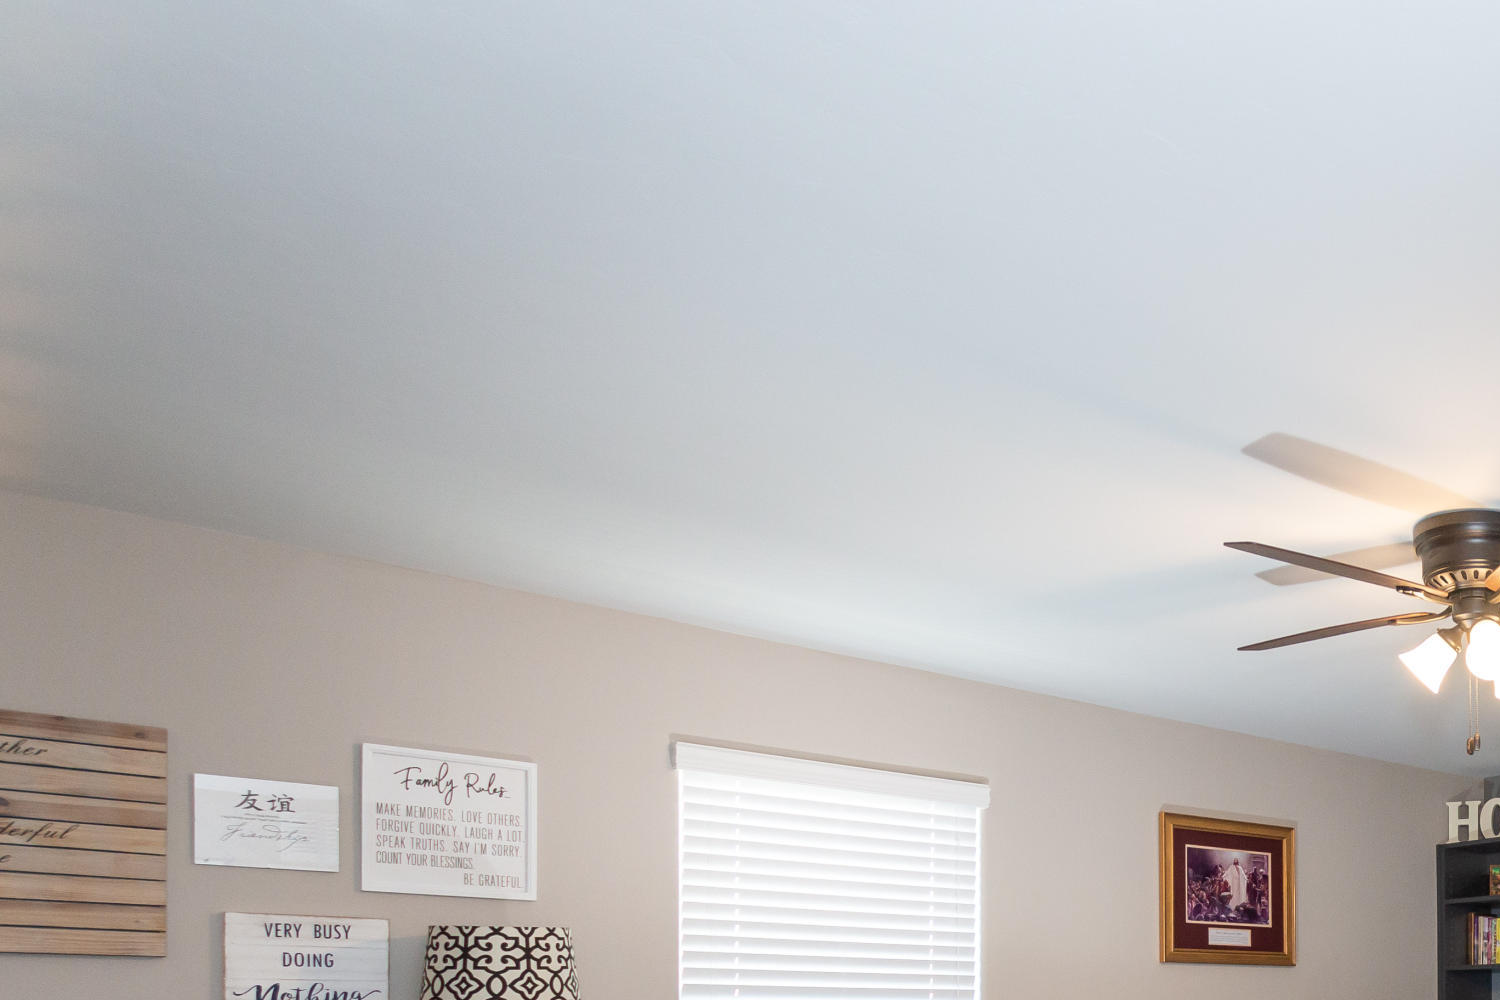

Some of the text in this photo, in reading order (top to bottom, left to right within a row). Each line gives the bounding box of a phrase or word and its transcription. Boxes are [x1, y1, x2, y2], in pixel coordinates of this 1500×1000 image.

[393, 762, 458, 806] Family
[234, 789, 296, 813] 友谊
[376, 802, 523, 827] MAKE MEMORIES. LOVE OTHERS.
[376, 818, 414, 834] FORGIVE
[419, 822, 460, 838] QUICKLY.
[464, 827, 493, 841] LAUGH
[497, 829, 503, 841] A
[376, 834, 406, 849] SPEAK
[411, 837, 448, 852] TRUTHS.
[452, 841, 472, 854] SAY
[491, 844, 522, 858] SORRY.
[376, 850, 475, 870] COUNT YOUR BLESSINGS.
[463, 873, 474, 886] BE
[264, 922, 352, 940] VERY BUSY
[282, 952, 334, 968] DOING
